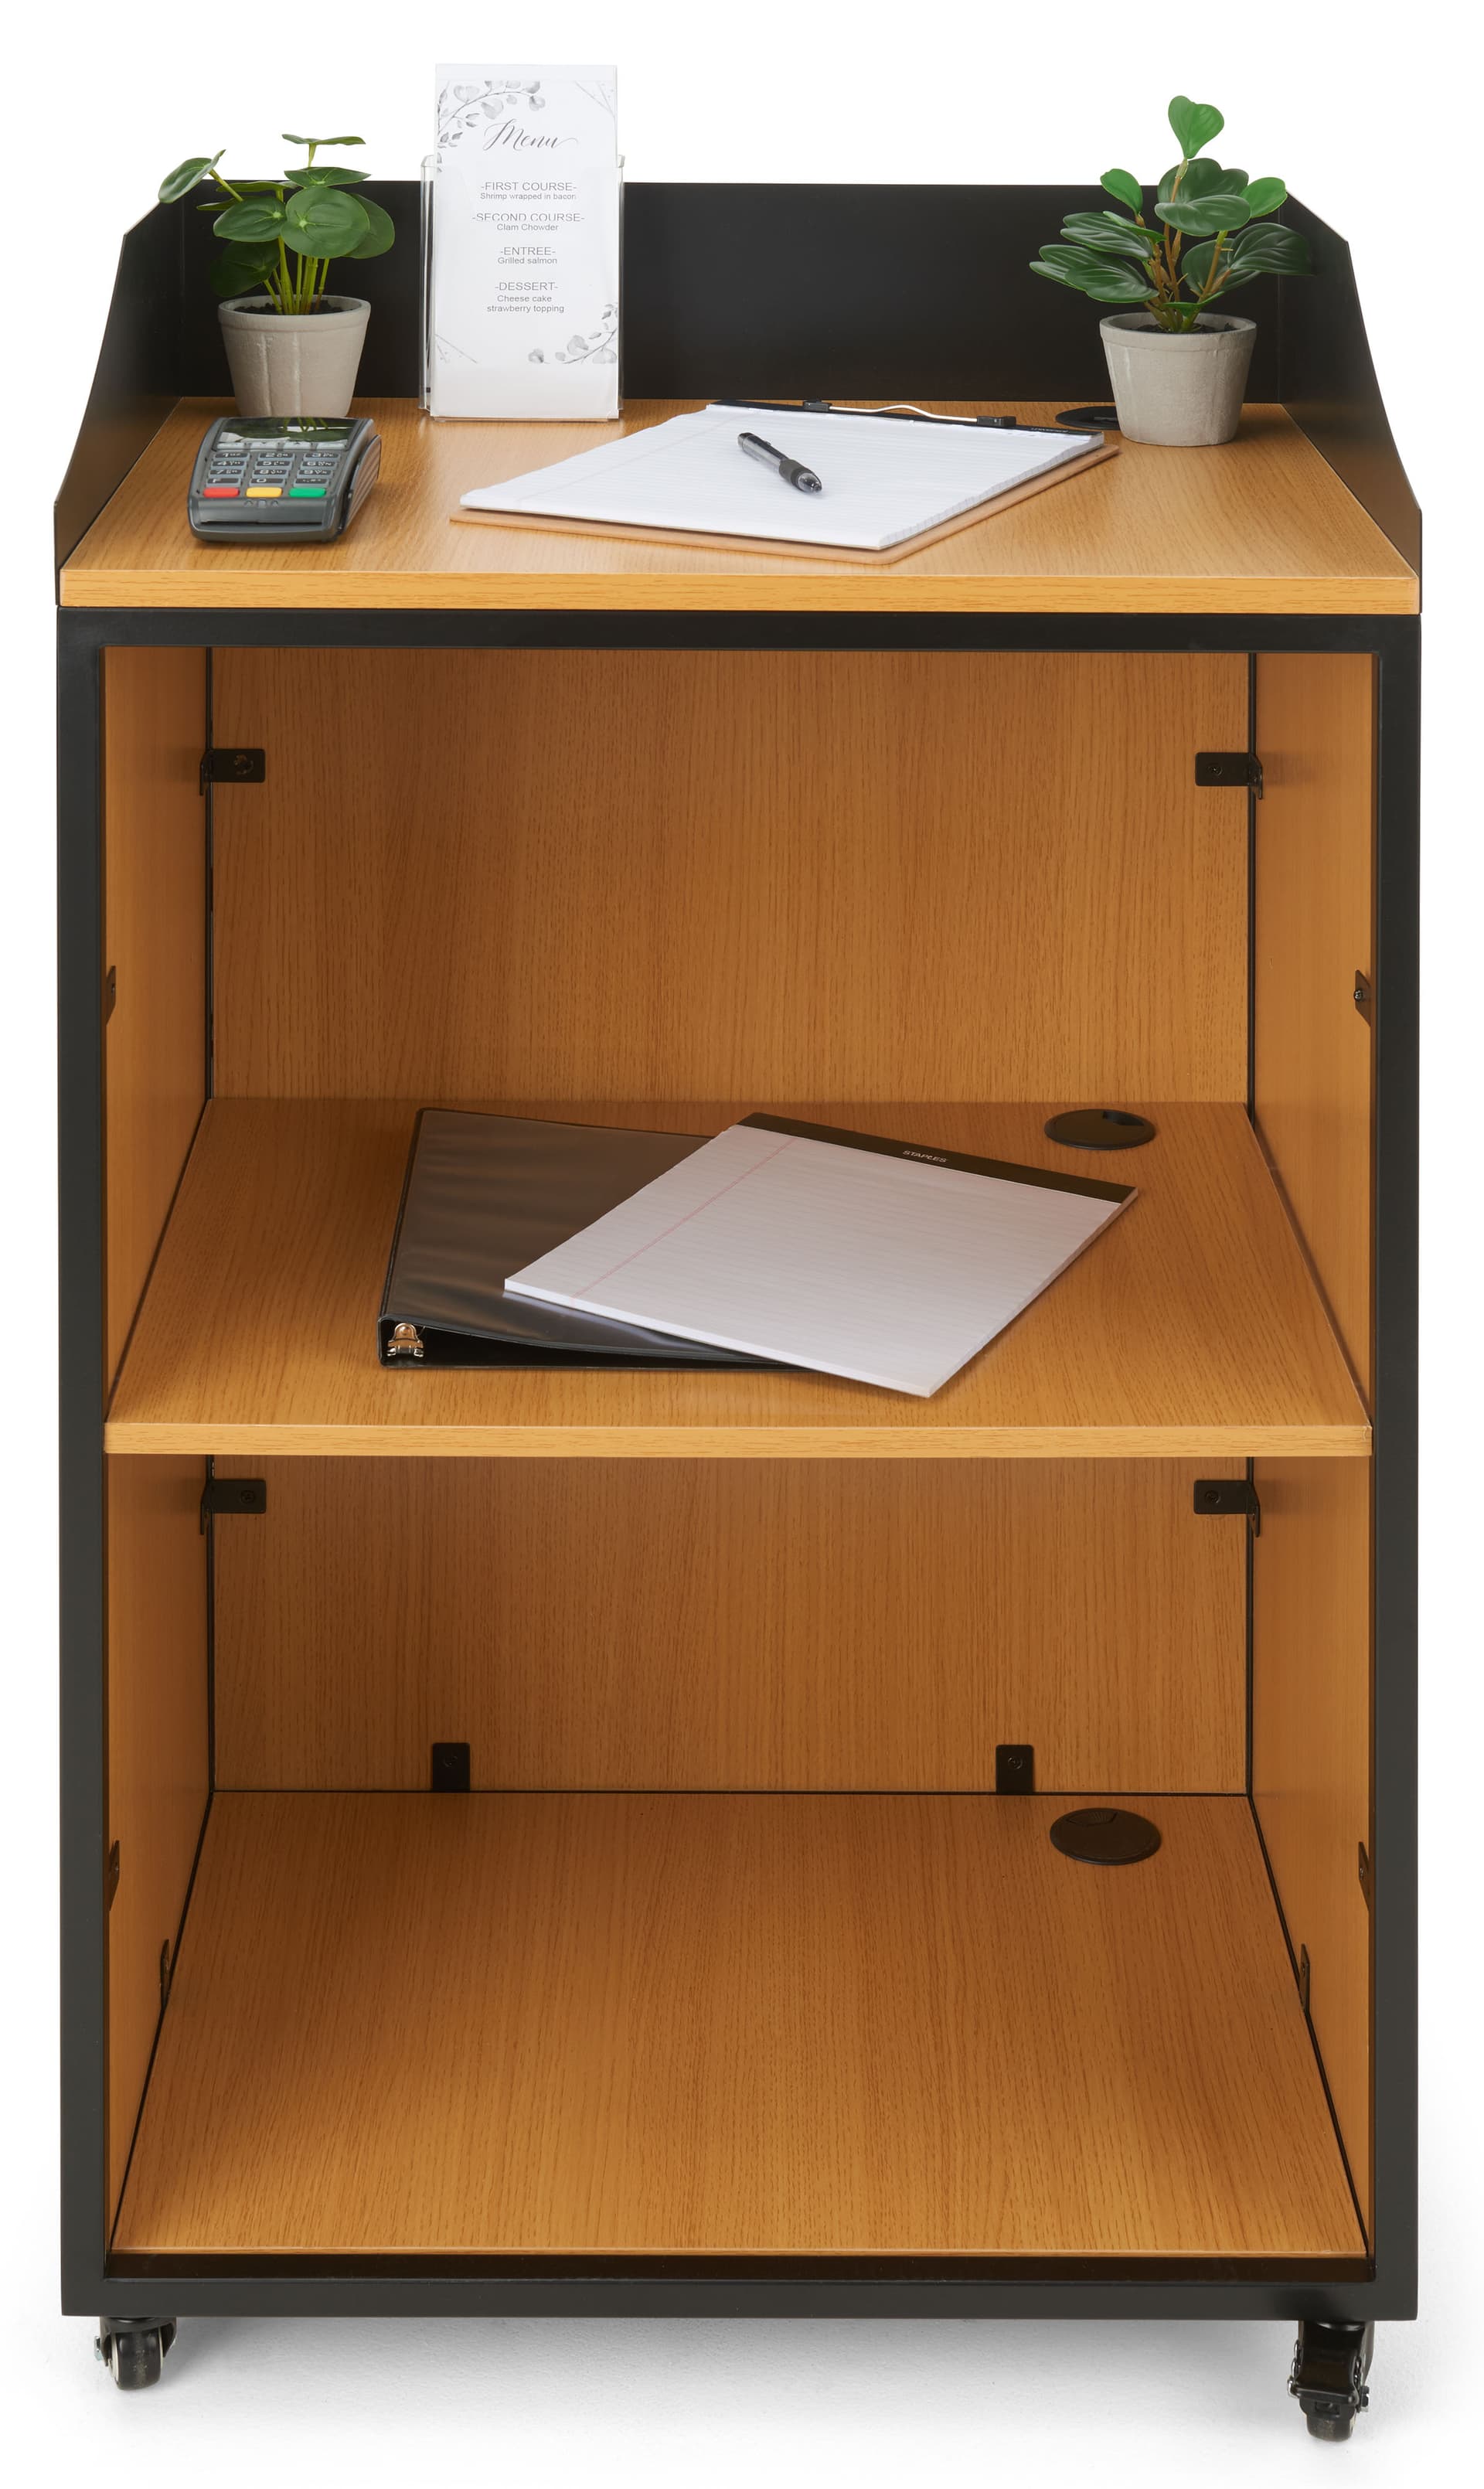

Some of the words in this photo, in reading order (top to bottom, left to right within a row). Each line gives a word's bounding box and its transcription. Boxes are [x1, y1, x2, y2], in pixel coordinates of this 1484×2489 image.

[482, 118, 579, 152] Menu
[480, 181, 519, 191] -FIRST
[522, 182, 577, 192] COURSE-
[480, 192, 507, 201] Shrimp
[529, 213, 585, 223] COURSE-
[496, 223, 519, 231] Clam
[521, 223, 560, 231] Chowder
[500, 247, 556, 256] -ENTREE-
[497, 256, 525, 264] Grilled
[495, 281, 559, 291] -DESSERT-
[487, 305, 531, 314] strawberry
[533, 305, 564, 314] topping
[902, 1150, 947, 1163] STAPLES
